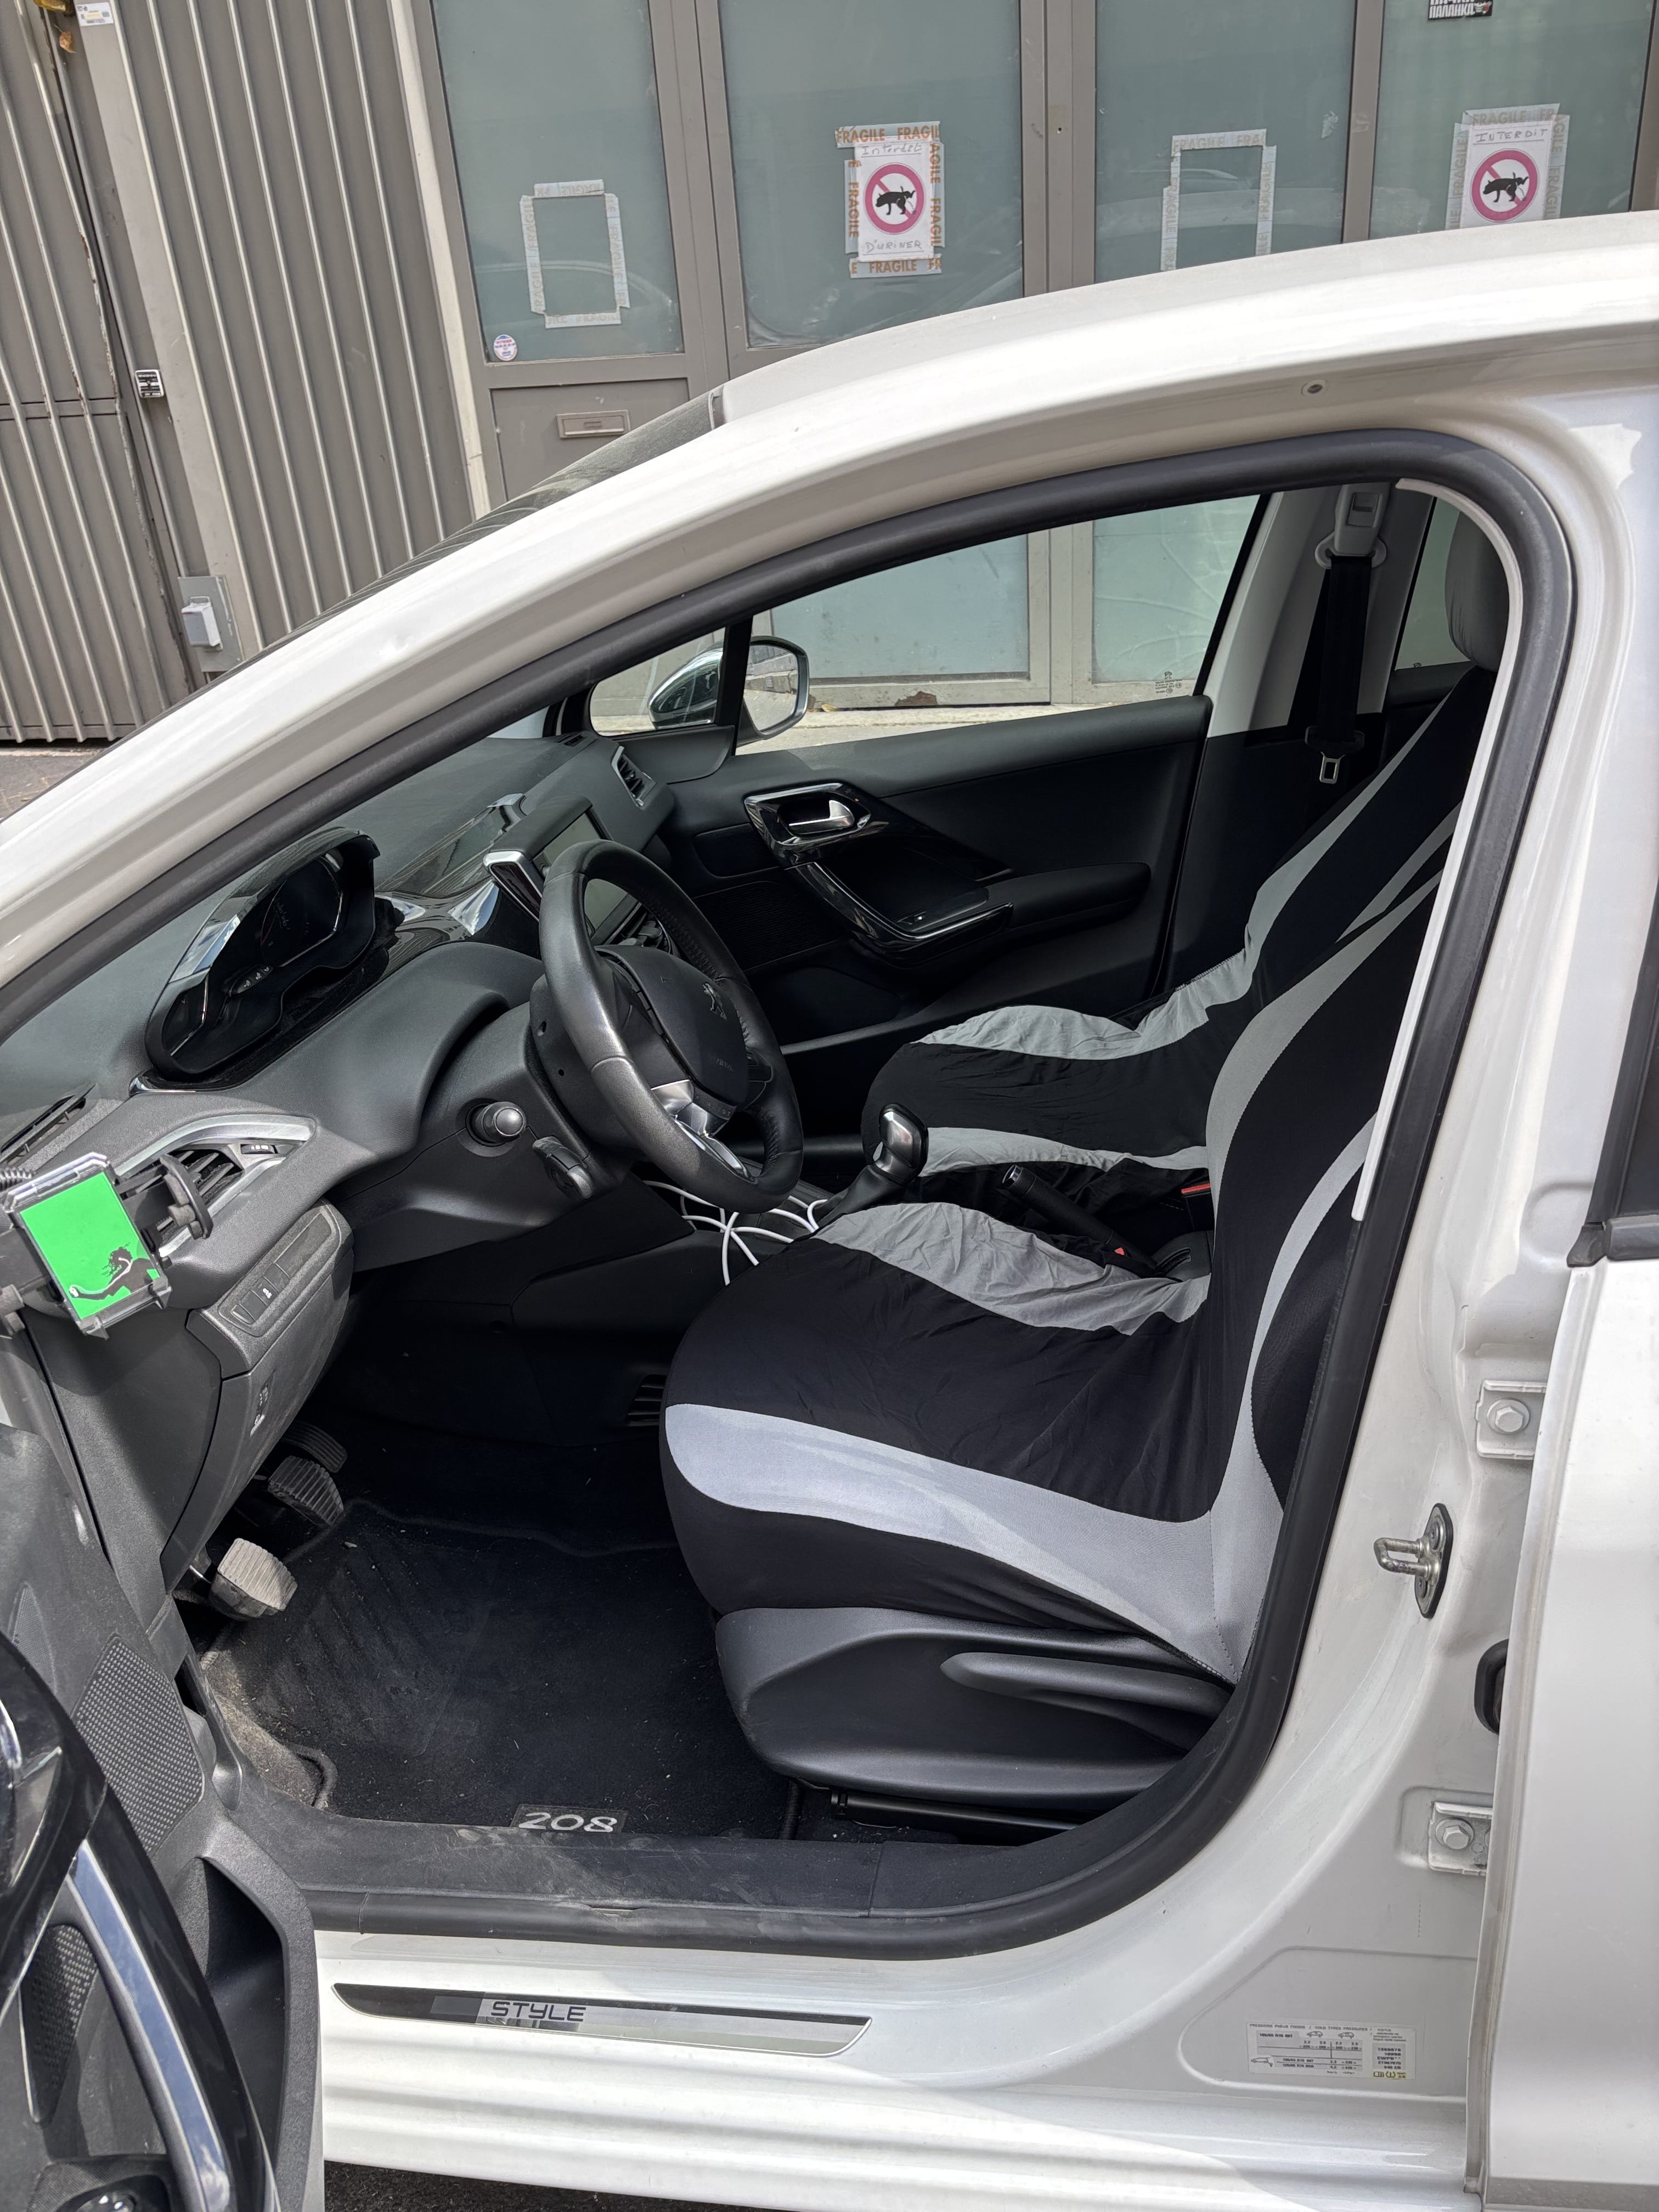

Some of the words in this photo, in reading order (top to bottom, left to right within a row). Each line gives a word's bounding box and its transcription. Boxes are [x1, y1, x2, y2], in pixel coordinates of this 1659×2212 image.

[1472, 110, 1526, 126] FRAGILE
[836, 126, 885, 143] FRAGILE
[848, 182, 860, 238] FRAGILE
[869, 259, 917, 273] FRAGILE
[518, 1812, 618, 1832] 208
[491, 2001, 586, 2022] STYLE
